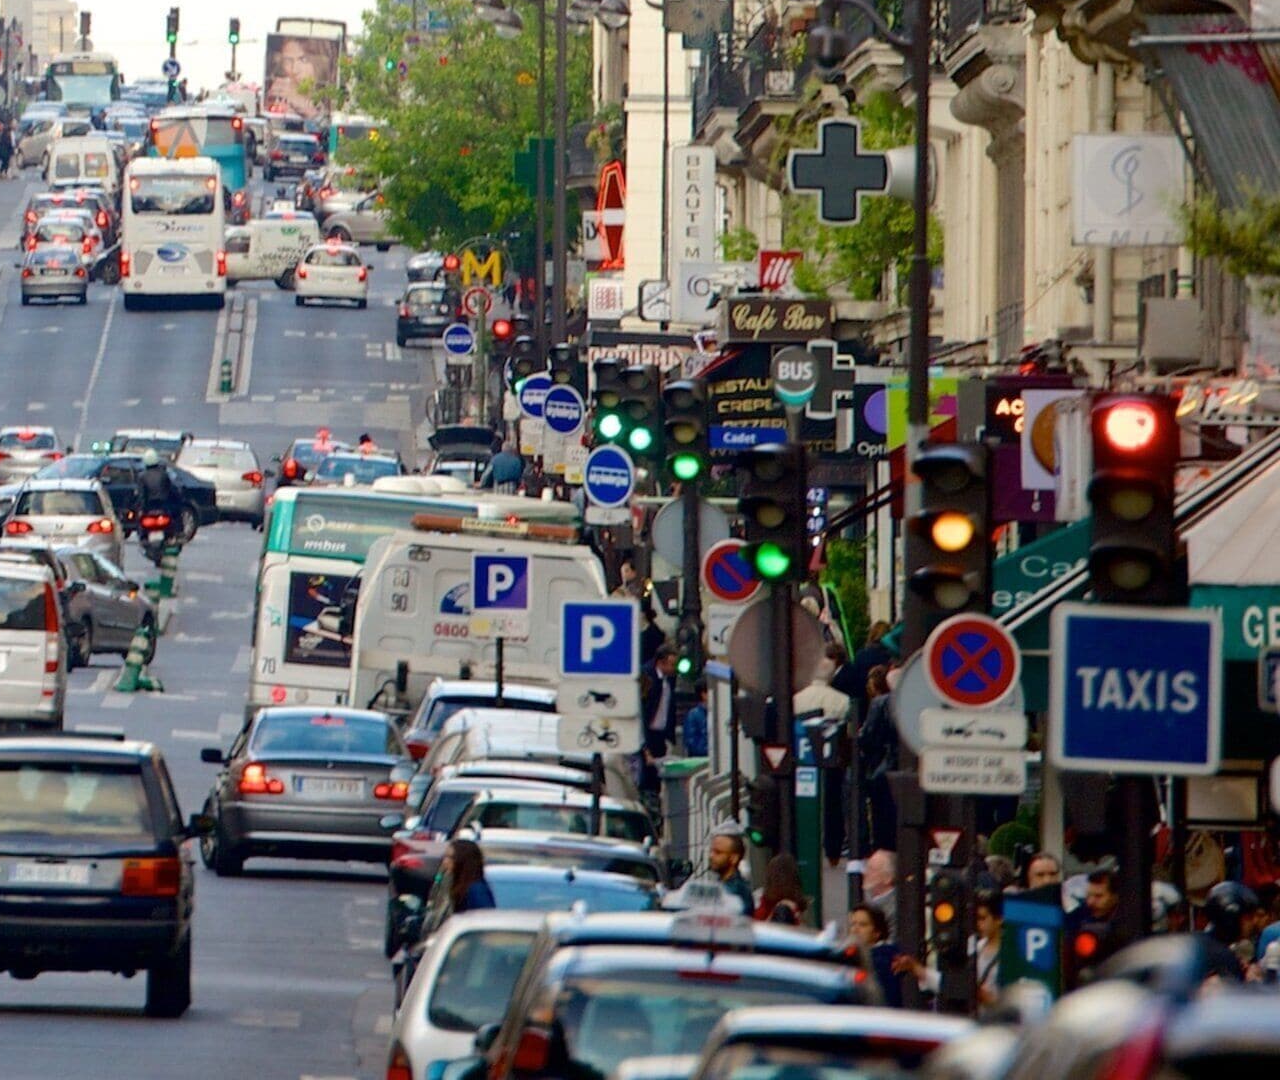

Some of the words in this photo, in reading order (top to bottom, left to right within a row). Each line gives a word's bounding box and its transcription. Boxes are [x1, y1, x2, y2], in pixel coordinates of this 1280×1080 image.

[463, 251, 502, 288] M
[762, 257, 793, 289] ill
[732, 303, 776, 340] Café
[783, 303, 825, 332] Bar
[777, 361, 813, 381] BUS
[723, 430, 757, 444] Cadet
[857, 440, 887, 458] Opti
[487, 563, 516, 602] P
[390, 593, 408, 612] 90
[433, 623, 469, 638] 0800
[580, 615, 616, 662] P
[1076, 666, 1199, 712] TAXIS
[1025, 928, 1048, 962] P
